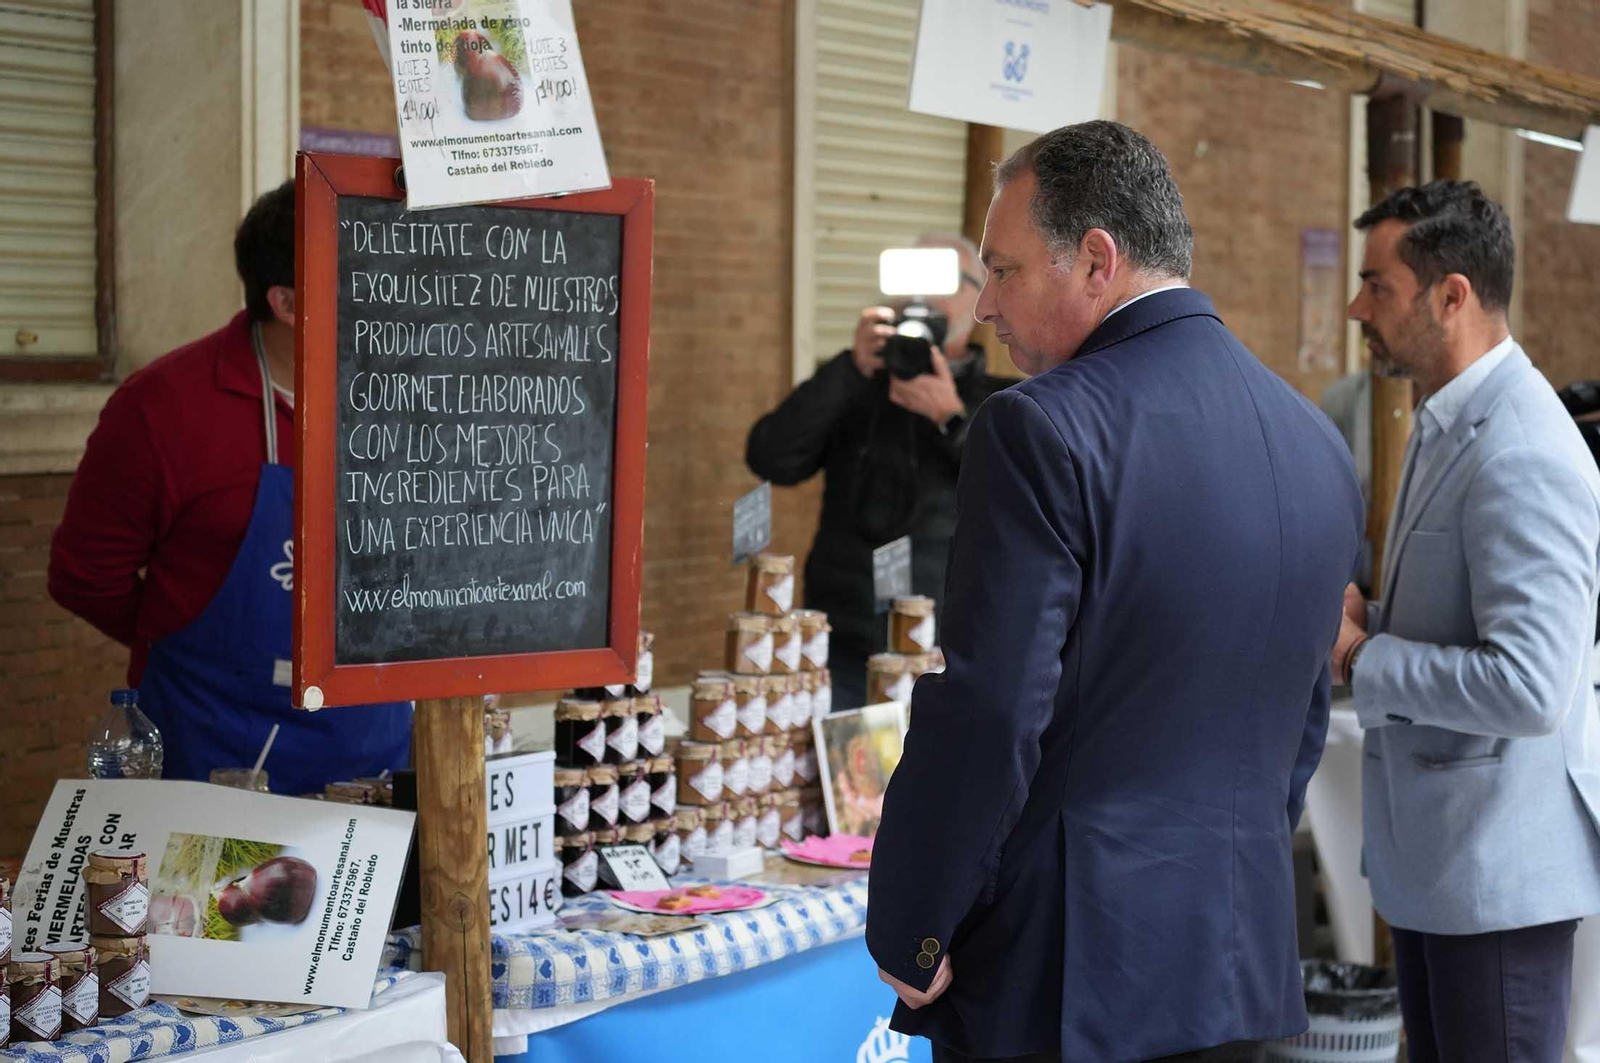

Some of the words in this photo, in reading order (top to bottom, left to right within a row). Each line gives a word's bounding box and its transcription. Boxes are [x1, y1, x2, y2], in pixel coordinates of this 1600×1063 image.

[413, 0, 453, 9] Sierra
[481, 15, 498, 29] de
[502, 14, 531, 28] vino
[401, 40, 432, 53] tinto
[436, 40, 453, 52] de
[530, 37, 554, 55] LOTE
[559, 37, 567, 53] 3
[532, 55, 569, 73] BOTES
[397, 59, 420, 76] LOTE
[422, 58, 431, 75] 3
[398, 77, 431, 94] BOTES
[410, 125, 583, 149] www.elmonumentoartesanal.com
[447, 163, 489, 177] Castaño
[491, 161, 508, 174] del
[510, 157, 554, 172] Robledo
[451, 150, 481, 162] Tlfno:
[485, 225, 531, 261] CON
[541, 229, 567, 265] LA
[491, 273, 517, 308] DE
[524, 275, 619, 316] NUESTROS
[355, 319, 477, 357] PRODUCTOS
[485, 321, 612, 363] ARTESANALES
[458, 374, 586, 415] ELABORADOS
[349, 423, 400, 462] CON
[406, 423, 447, 464] LOS
[455, 422, 562, 467] MEJORES
[346, 468, 522, 505] INGREDIENTES
[533, 463, 591, 501] PARA
[346, 517, 396, 554] UNA
[405, 506, 533, 550] EXPERIENCIA
[52, 788, 87, 849] Muestras
[99, 812, 122, 845] CON
[45, 852, 62, 870] de
[360, 853, 379, 895] Robledo
[27, 872, 54, 923] Ferias
[303, 817, 358, 996] www.elmonumentoartesanal.com
[328, 920, 346, 953] Tlfno:
[341, 858, 362, 920] 673375967.
[354, 894, 367, 915] del
[342, 917, 362, 962] Castaño
